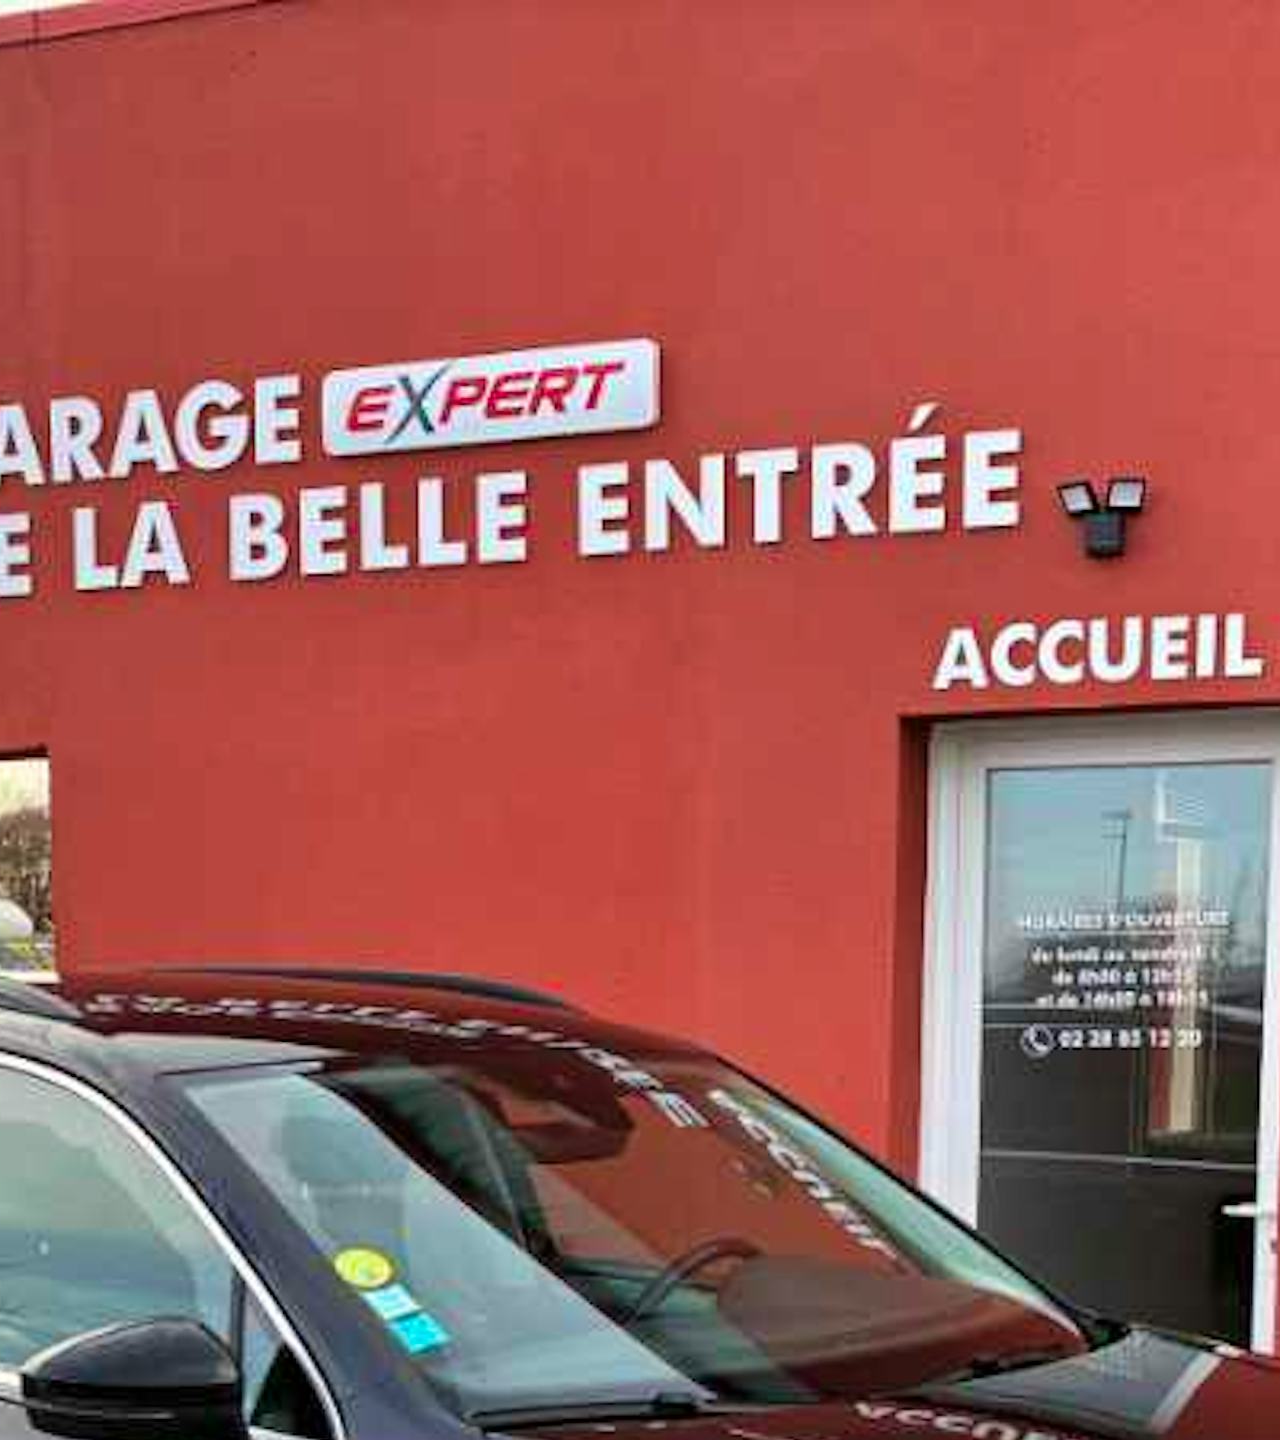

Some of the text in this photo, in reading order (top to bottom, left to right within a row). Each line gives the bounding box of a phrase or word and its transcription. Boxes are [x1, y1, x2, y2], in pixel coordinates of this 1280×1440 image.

[73, 501, 190, 591] LA
[229, 472, 529, 581] BELLE
[577, 403, 1022, 557] ENTRÉE
[932, 613, 1265, 691] ACCUEIL
